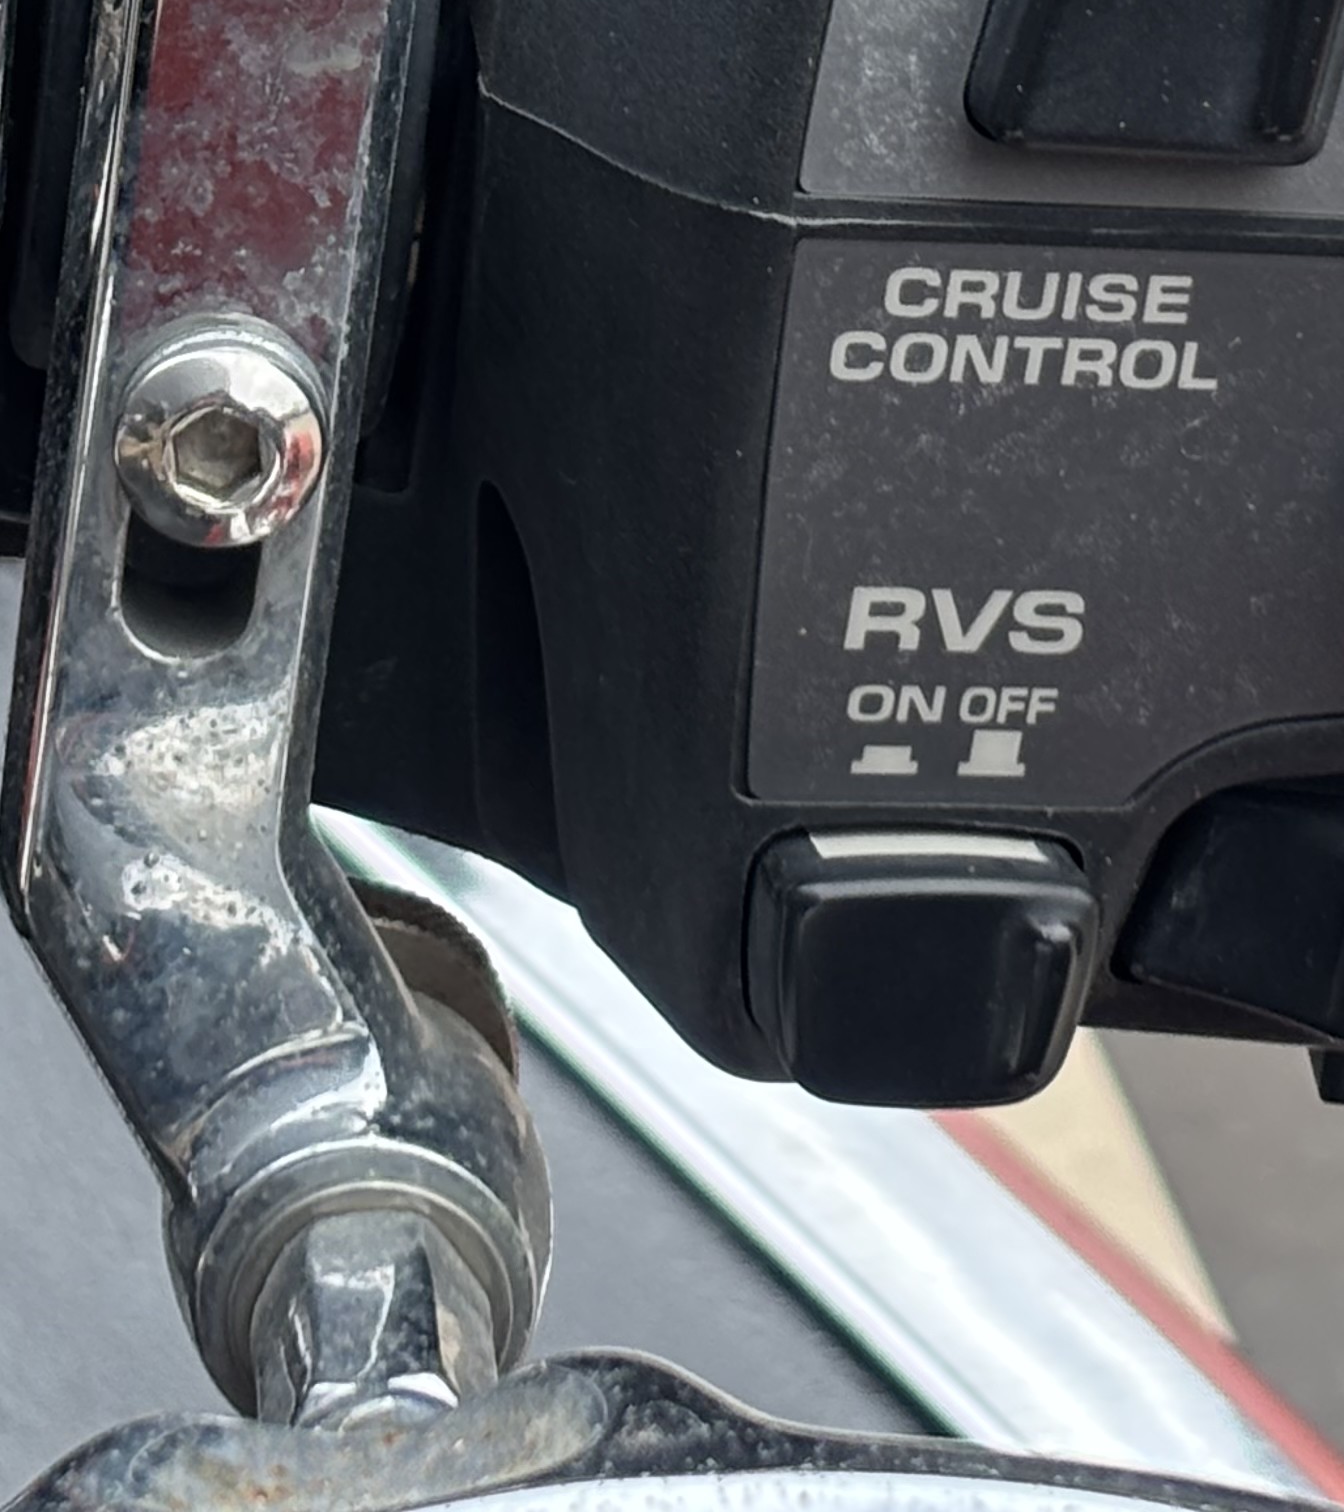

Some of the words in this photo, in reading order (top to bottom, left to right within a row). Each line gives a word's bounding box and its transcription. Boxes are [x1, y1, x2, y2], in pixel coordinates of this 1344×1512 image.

[884, 267, 1193, 324] CRUISE
[829, 331, 1218, 391] CONTROL
[843, 586, 1085, 655] RVS
[846, 684, 947, 723] ON
[959, 687, 1059, 725] OFF
